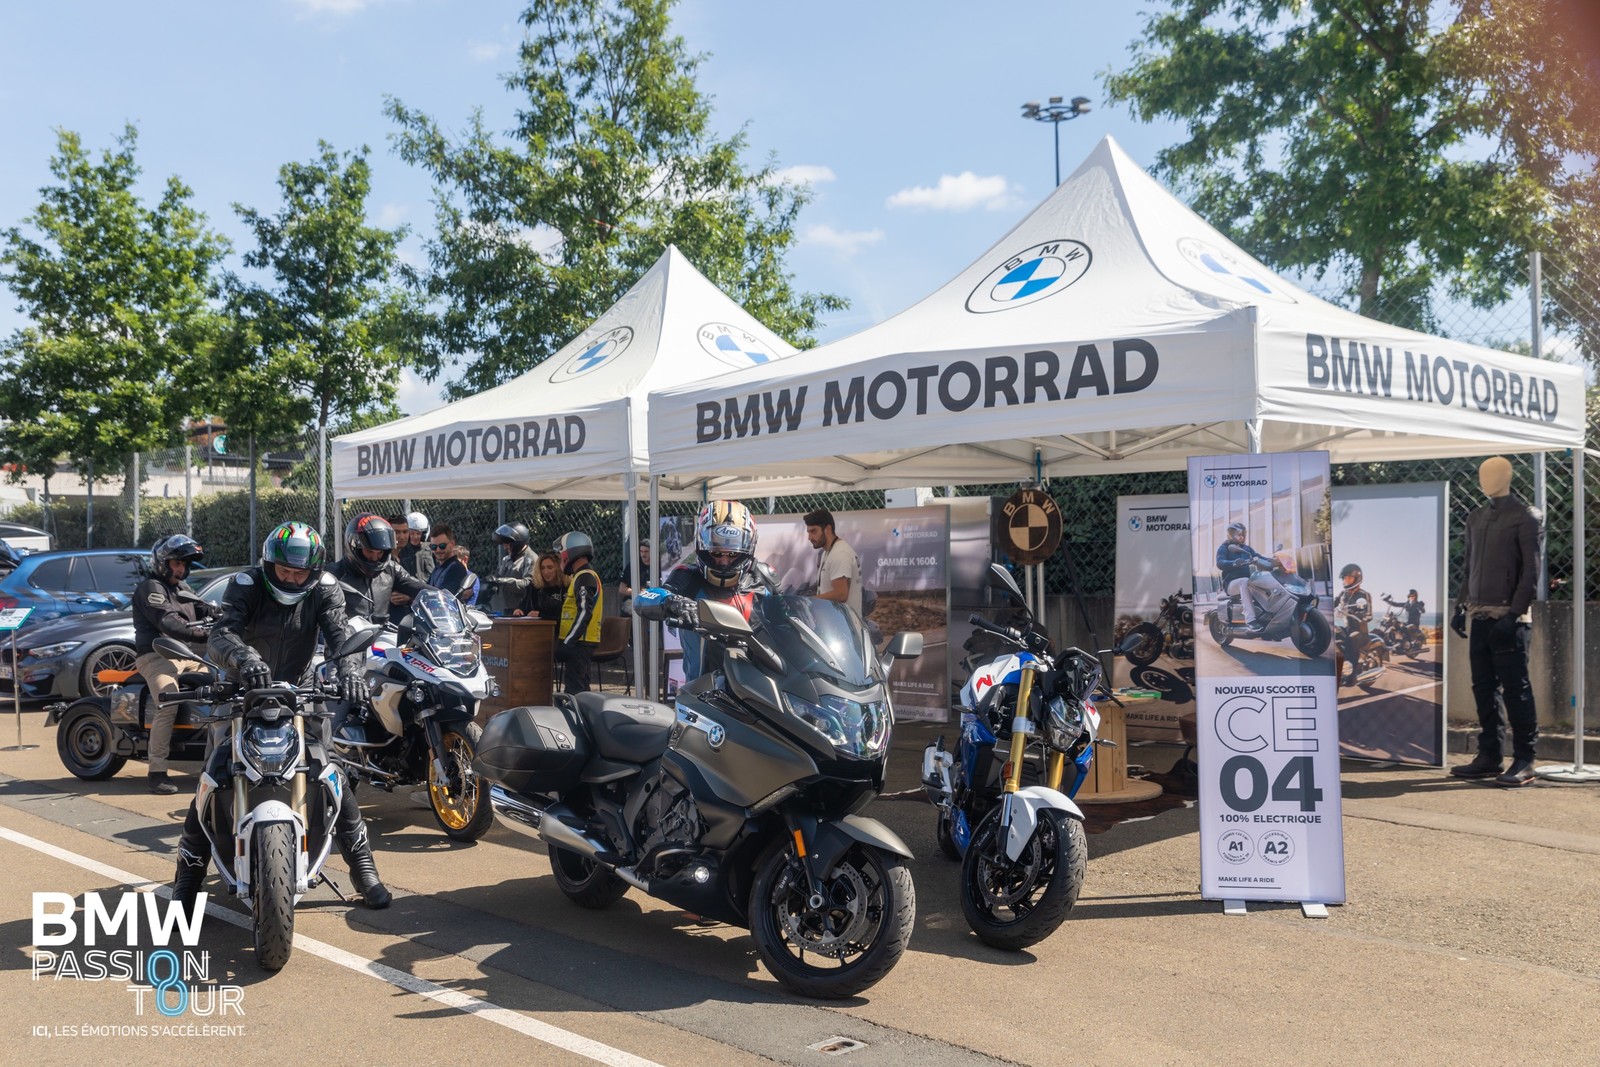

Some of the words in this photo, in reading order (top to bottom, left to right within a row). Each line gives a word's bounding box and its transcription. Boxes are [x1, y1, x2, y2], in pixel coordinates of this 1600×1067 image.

[1003, 243, 1085, 272] BMW
[702, 325, 756, 344] BMW
[1306, 333, 1393, 398] BMW
[1404, 351, 1559, 423] MOTORRAD
[696, 385, 808, 444] BMW
[822, 338, 1160, 427] MOTORRAD
[357, 437, 417, 477] BMW
[423, 415, 586, 469] MOTORRAD
[1221, 473, 1242, 481] BMW
[1221, 479, 1268, 488] MOTORRAD
[1003, 491, 1056, 517] BMW
[1146, 514, 1168, 523] BMW
[719, 527, 739, 537] Arai
[877, 557, 909, 567] GAMME
[909, 557, 916, 566] K
[1214, 686, 1265, 695] NOUVEAU
[1266, 685, 1316, 694] SCOOTER
[1145, 713, 1159, 721] LIFE
[1214, 695, 1319, 753] CE
[1219, 754, 1323, 813] 04
[1219, 814, 1250, 823] 100%
[1253, 815, 1322, 824] ELECTRIQUE
[1228, 841, 1243, 852] A1
[1264, 841, 1289, 855] A2
